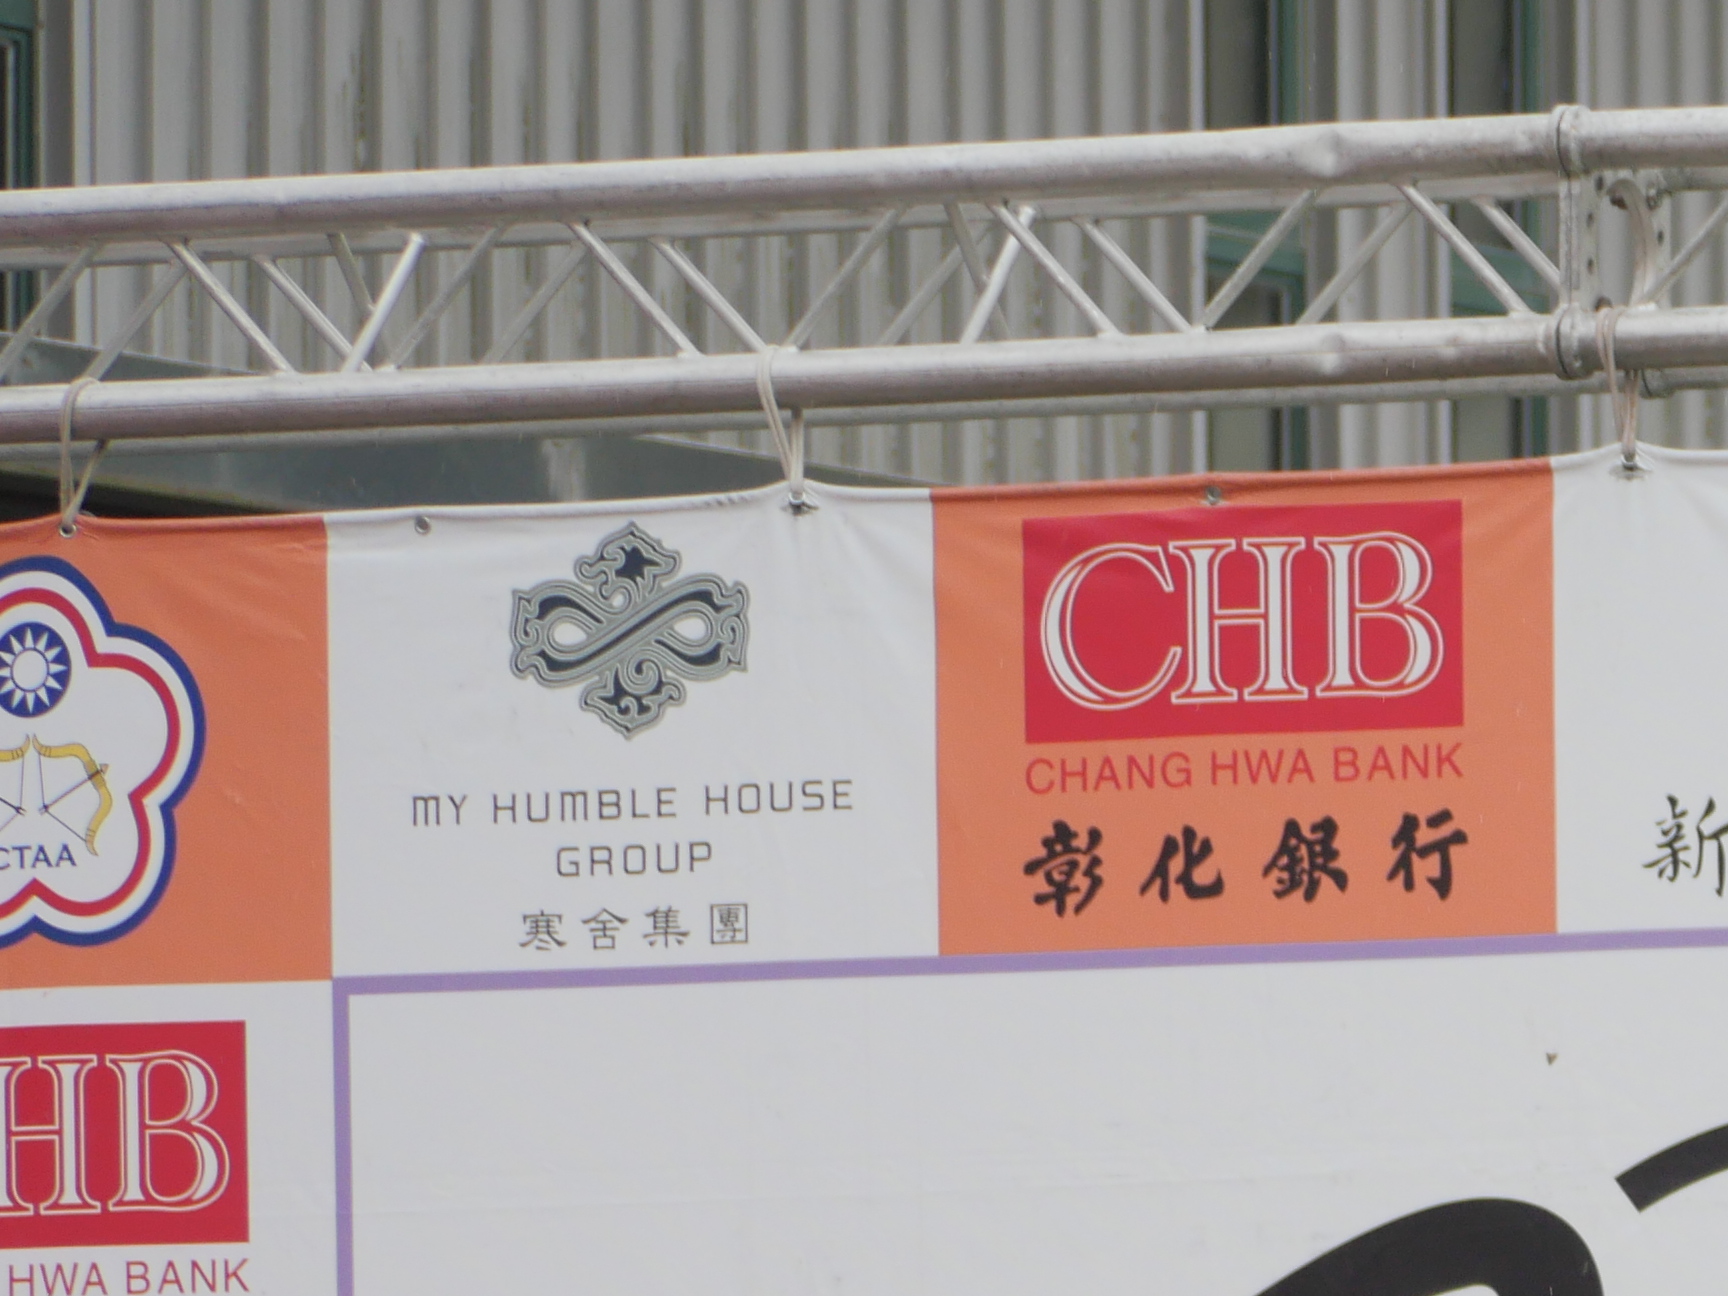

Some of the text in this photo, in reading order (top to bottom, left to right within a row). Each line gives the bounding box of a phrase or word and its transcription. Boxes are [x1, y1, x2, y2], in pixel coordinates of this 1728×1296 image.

[1040, 531, 1444, 712] CHB
[1025, 742, 1464, 795] CHANG HWA BANK
[411, 780, 854, 827] MY HUMBLE HOUSE
[556, 841, 714, 879] GROUP
[1023, 808, 1468, 918] 彰化銀行
[519, 903, 748, 952] 寒舍集團
[0, 1050, 230, 1217] HB
[125, 1259, 250, 1295] BANK
